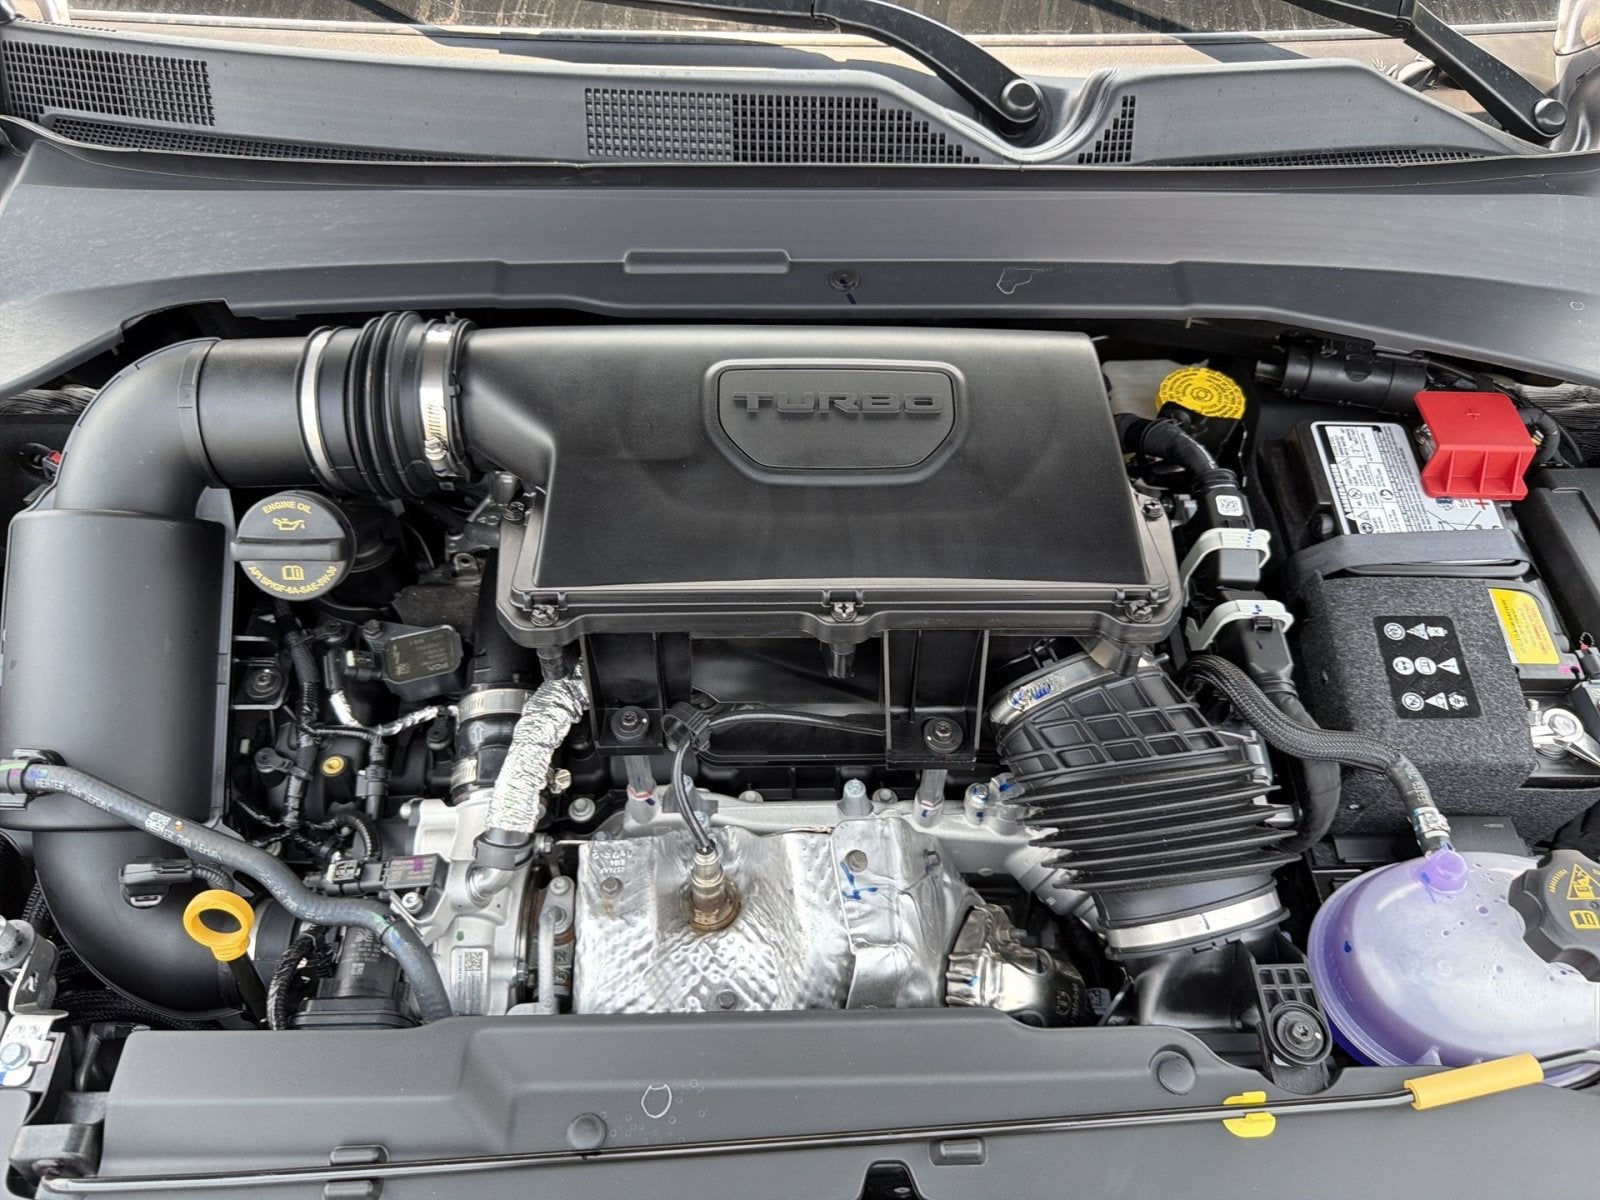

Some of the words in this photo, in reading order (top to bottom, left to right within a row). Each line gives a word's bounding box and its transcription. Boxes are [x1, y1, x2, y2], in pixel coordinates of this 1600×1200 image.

[733, 391, 944, 415] TURBO
[262, 500, 296, 514] ENGINE
[297, 502, 312, 514] OIL
[248, 566, 263, 580] API
